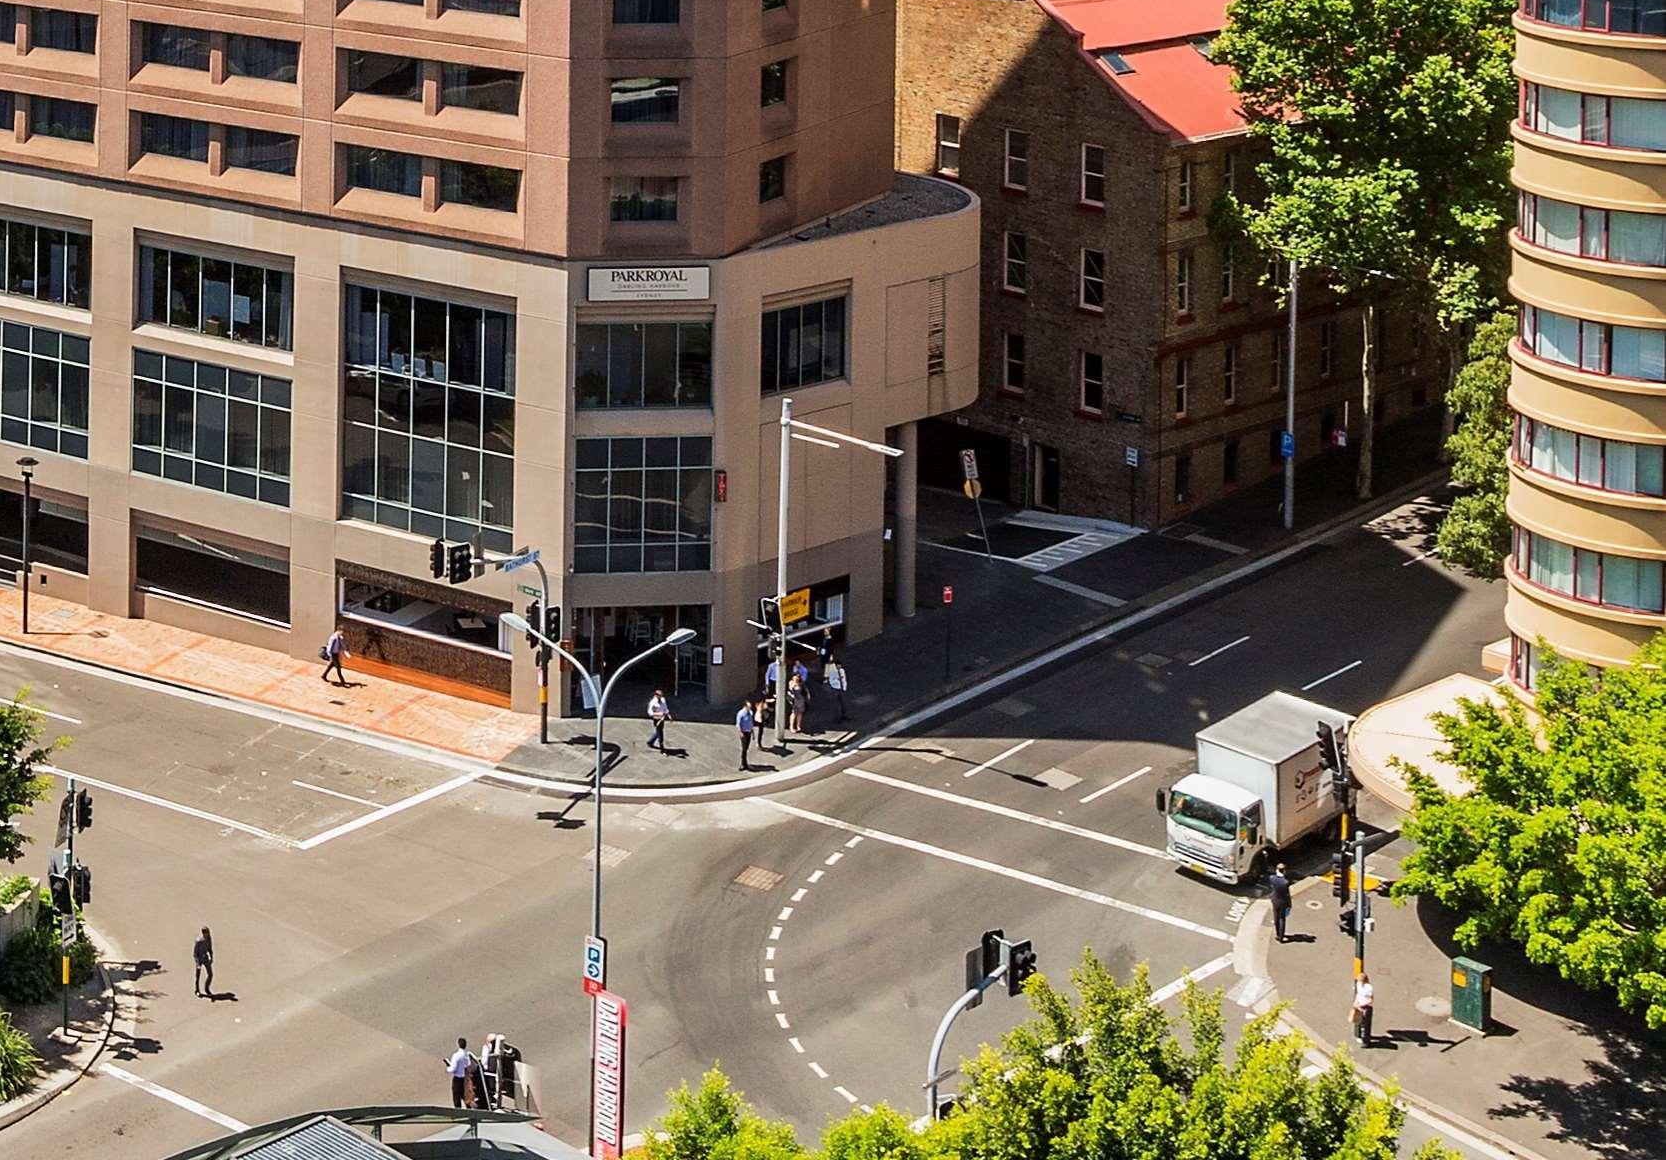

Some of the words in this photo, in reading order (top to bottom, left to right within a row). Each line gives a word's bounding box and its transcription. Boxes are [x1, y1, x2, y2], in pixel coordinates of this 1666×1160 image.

[611, 270, 688, 282] PARKROYAL
[598, 998, 620, 1070] DARLING
[597, 1069, 618, 1147] HARBOUR
